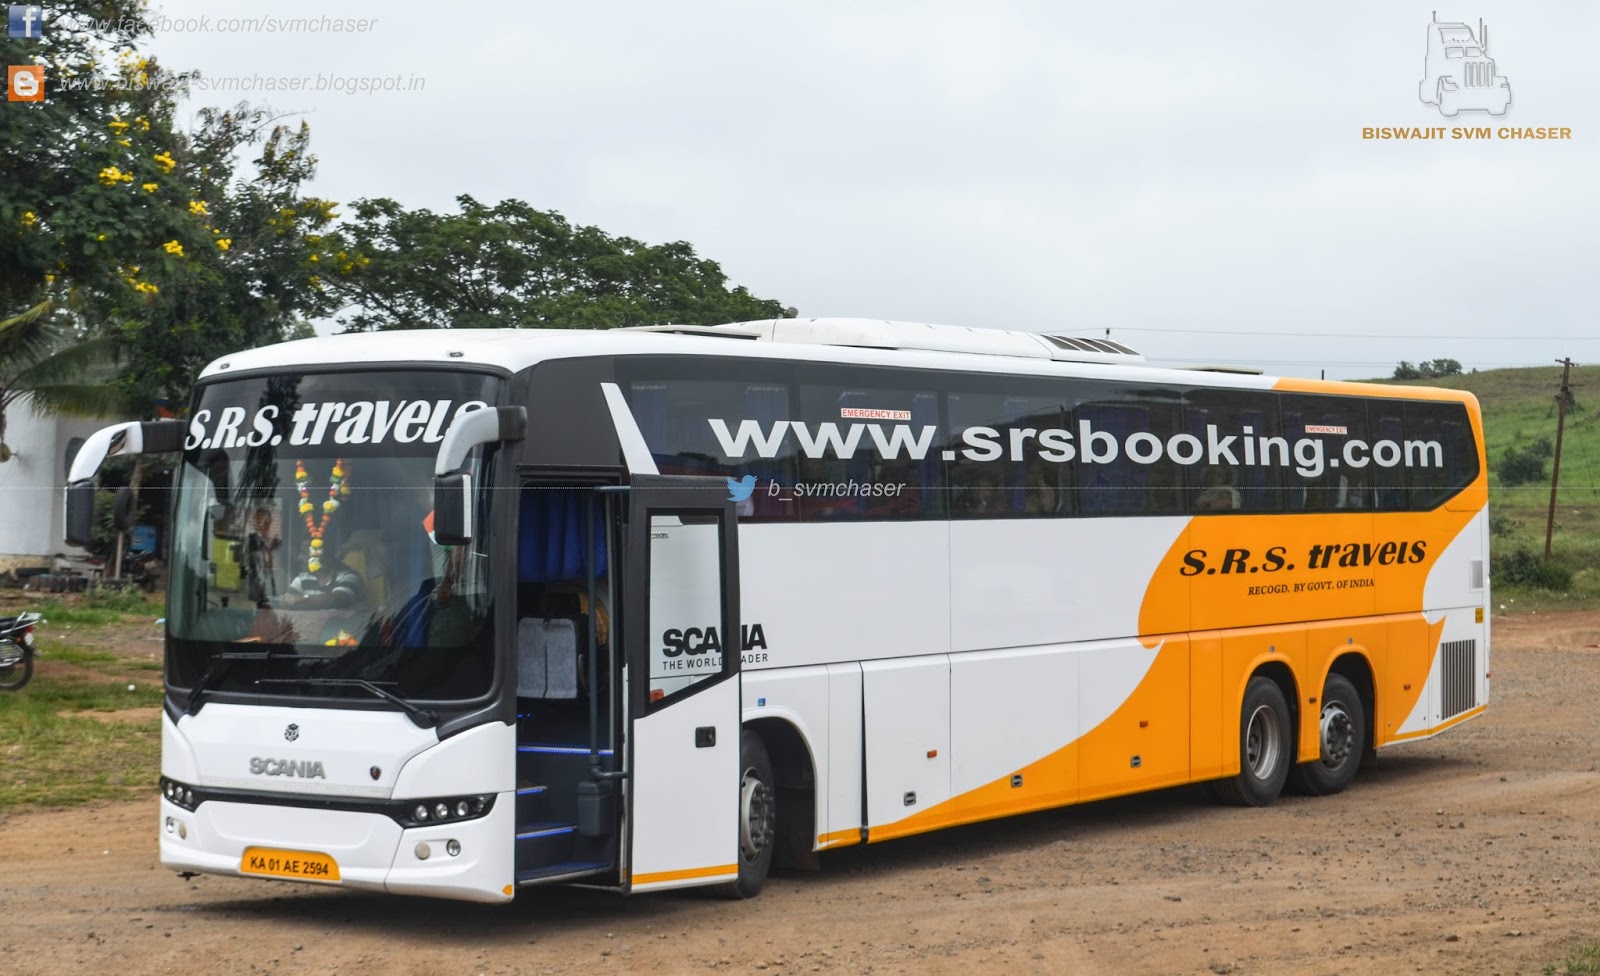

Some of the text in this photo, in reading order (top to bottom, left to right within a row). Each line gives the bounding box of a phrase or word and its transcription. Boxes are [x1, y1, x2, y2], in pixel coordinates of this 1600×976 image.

[842, 409, 910, 419] EMERGENCY EXIT
[184, 404, 283, 450] S.R.S.
[708, 418, 1444, 478] www.srsbooking.com
[1179, 540, 1427, 577] S.R.S. travels
[1248, 578, 1375, 596] RECOGD. BY GOVT. OF INDIA
[662, 623, 768, 657] SCAIA
[662, 661, 684, 671] THE
[249, 757, 326, 780] SCANIA
[250, 856, 329, 875] KA 01 AE 2594
